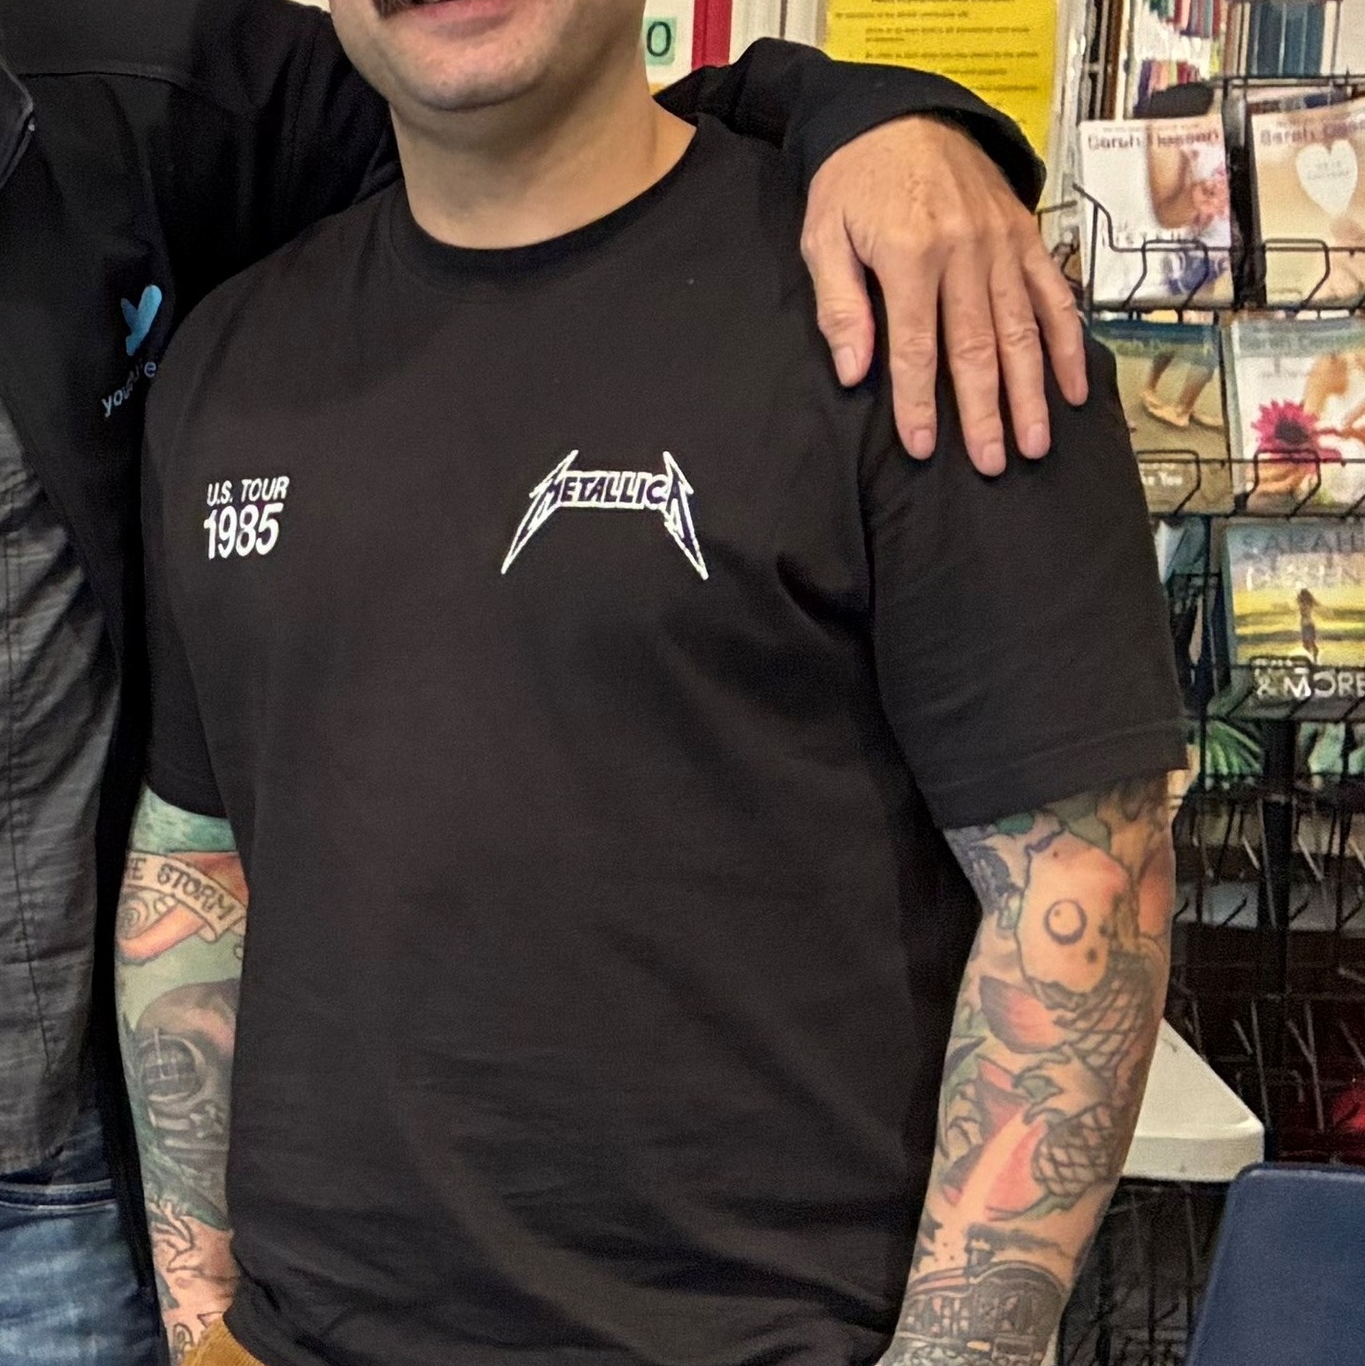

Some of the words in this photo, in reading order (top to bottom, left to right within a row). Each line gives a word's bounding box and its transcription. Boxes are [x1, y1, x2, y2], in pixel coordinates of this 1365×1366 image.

[207, 480, 234, 506] U.S.
[241, 476, 290, 503] TOUR
[501, 450, 709, 580] METALLICA
[203, 502, 284, 560] 1985
